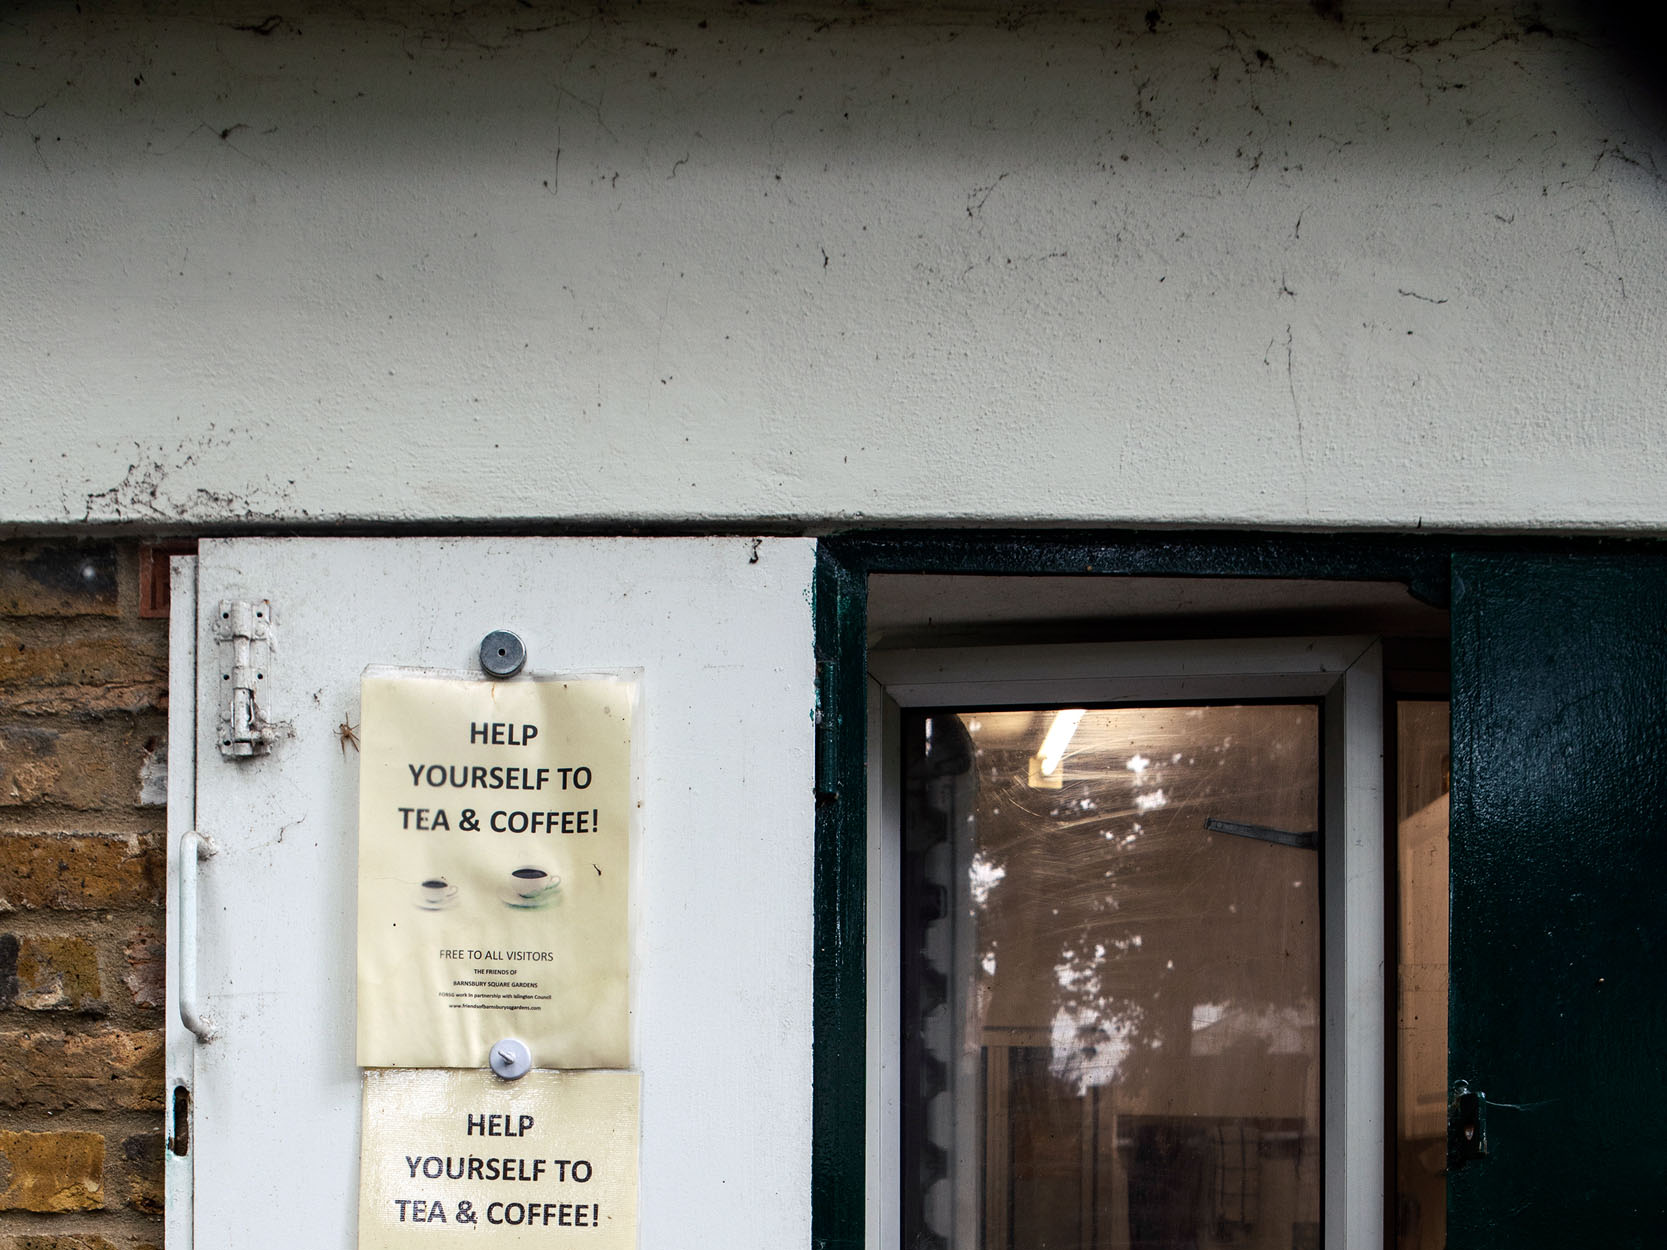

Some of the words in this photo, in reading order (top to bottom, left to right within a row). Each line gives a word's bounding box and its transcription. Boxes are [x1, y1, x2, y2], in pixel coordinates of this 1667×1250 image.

[470, 722, 538, 746] HELP
[408, 764, 550, 790] YOURSELF
[557, 766, 592, 790] TO
[398, 807, 450, 831] TEA
[458, 808, 481, 832] &
[490, 809, 599, 834] COFFEE!
[439, 949, 464, 959] FREE
[467, 950, 482, 960] TO
[484, 950, 503, 960] ALL
[506, 951, 554, 962] VISITORS
[467, 1114, 534, 1137] HELP
[405, 1156, 547, 1182] YOURSELF
[554, 1160, 593, 1183] TO
[395, 1199, 447, 1224] TEA
[455, 1200, 478, 1225] &
[486, 1202, 599, 1228] COFFEE!
